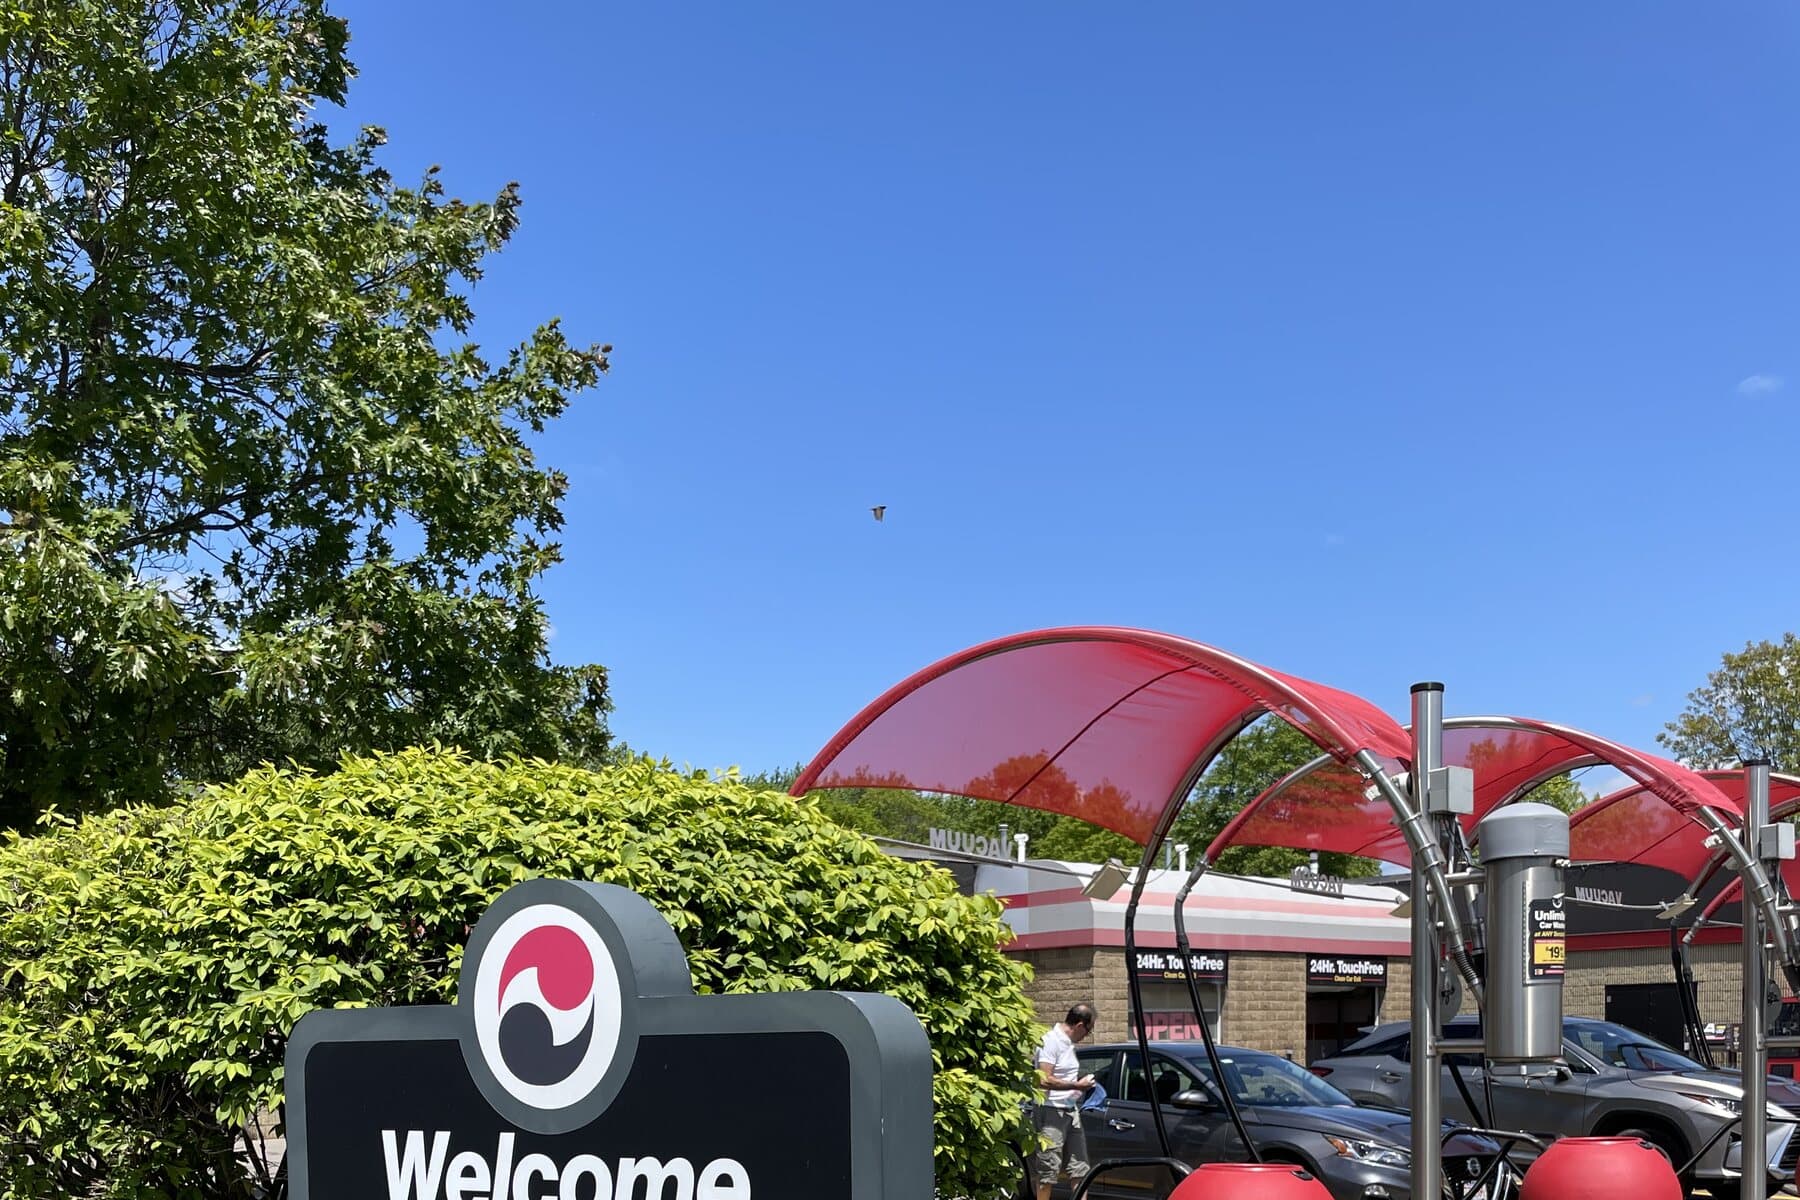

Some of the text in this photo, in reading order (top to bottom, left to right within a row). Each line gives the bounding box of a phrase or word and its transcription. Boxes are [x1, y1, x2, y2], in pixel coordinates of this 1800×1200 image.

[1136, 954, 1165, 969] 24Hr.
[1310, 960, 1384, 975] 24Hr. TouchFree
